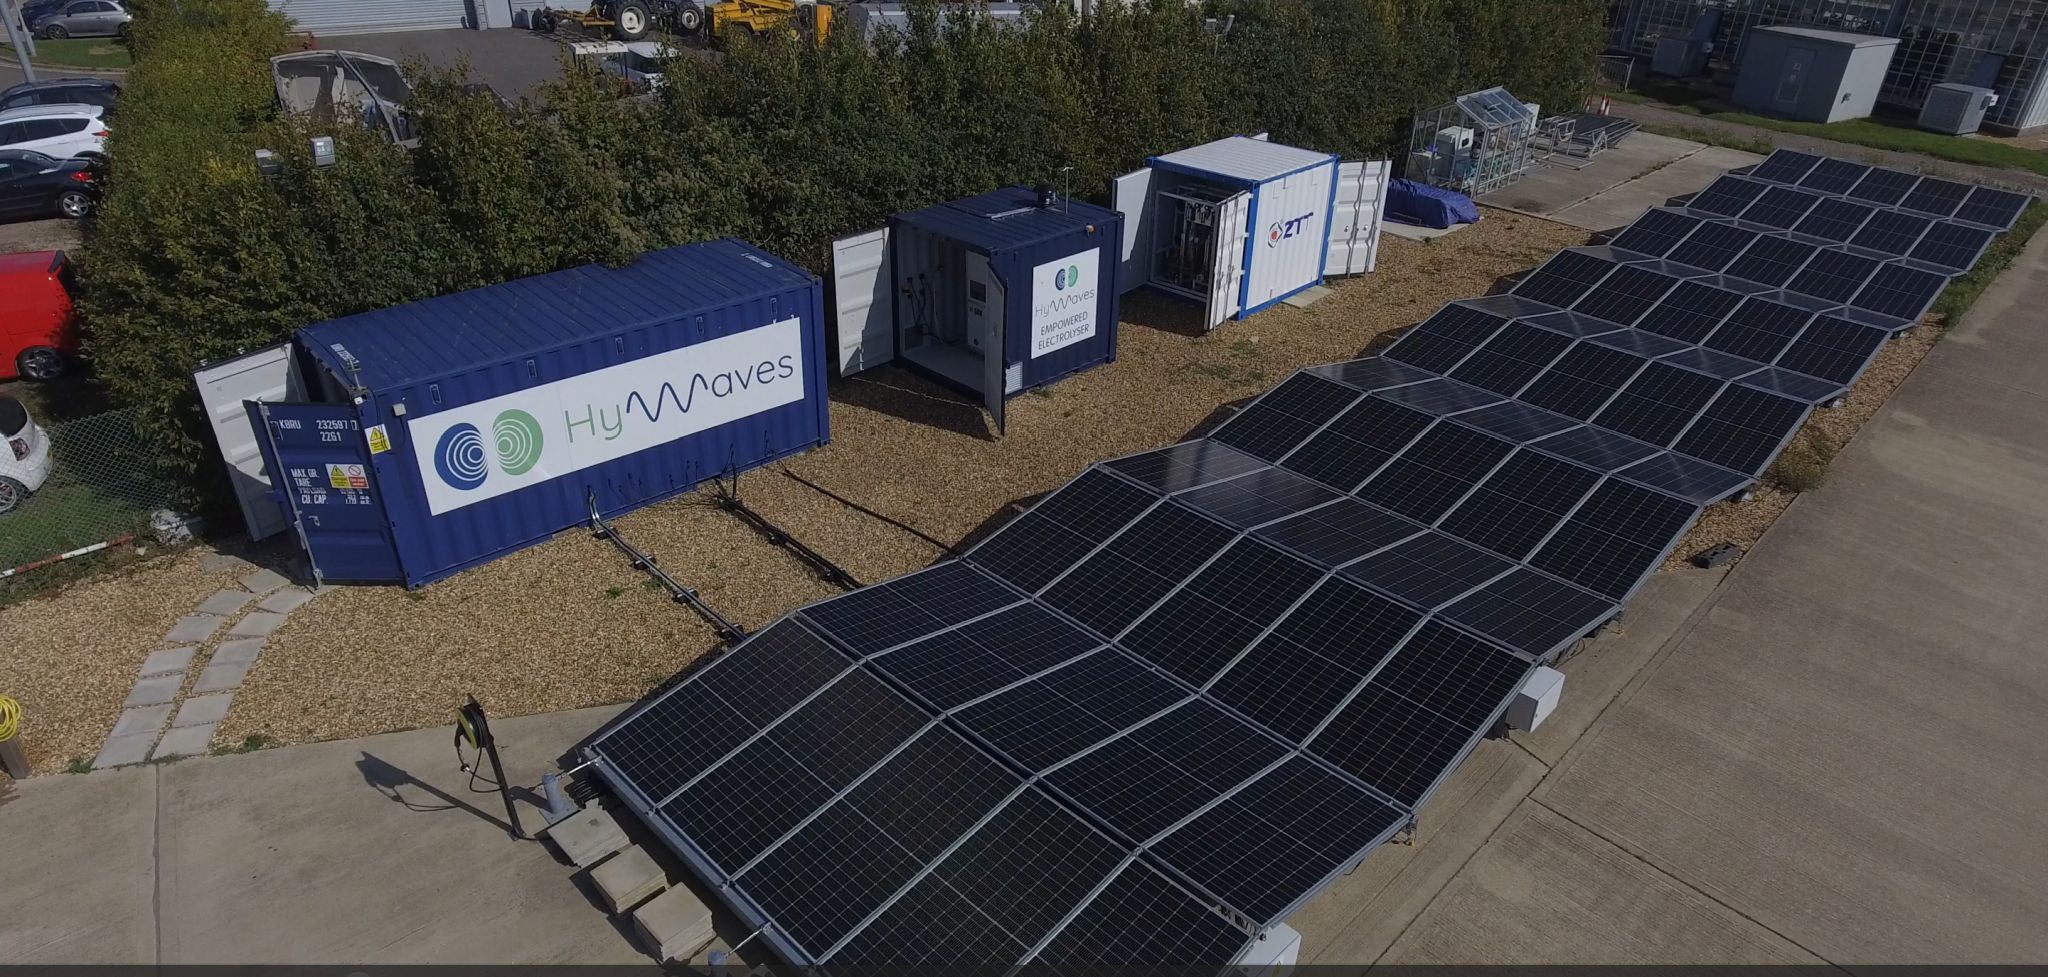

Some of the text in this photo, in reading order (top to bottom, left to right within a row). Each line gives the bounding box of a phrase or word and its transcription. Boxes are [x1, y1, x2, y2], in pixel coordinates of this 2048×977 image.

[1283, 211, 1314, 239] ZTT
[1035, 289, 1095, 317] HyWaves
[1038, 324, 1090, 350] ELECTROLYSER
[1041, 311, 1088, 336] EMPOWERED
[565, 355, 794, 443] HyWaves
[279, 419, 302, 430] KBRU
[316, 419, 348, 430] 232597
